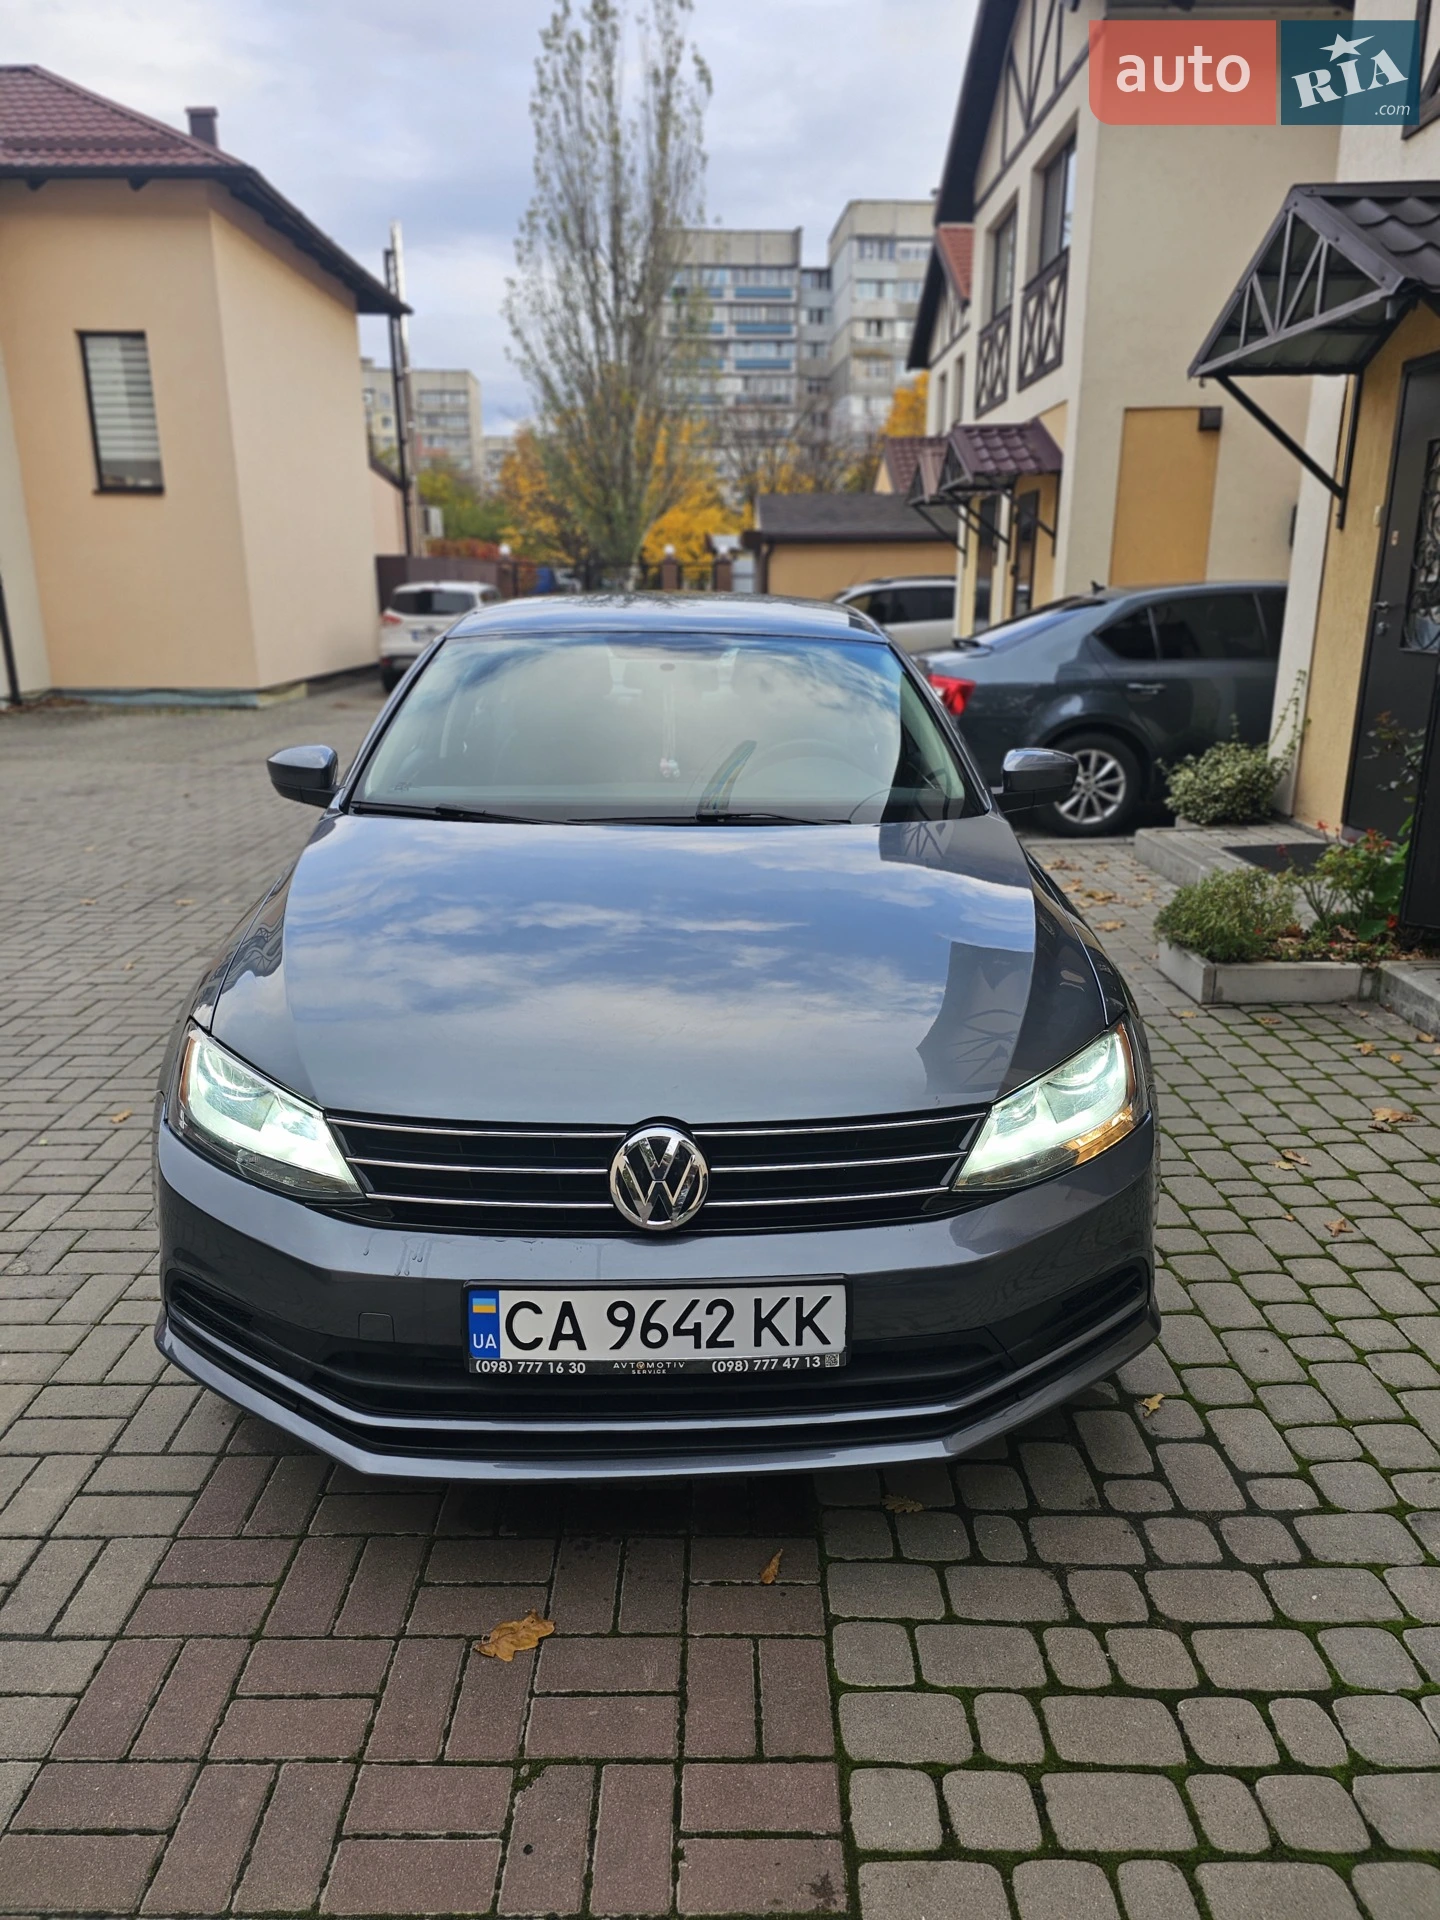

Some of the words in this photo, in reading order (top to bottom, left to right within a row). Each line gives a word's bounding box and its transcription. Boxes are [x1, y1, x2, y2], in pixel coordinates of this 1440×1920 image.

[504, 1300, 588, 1351] CA
[605, 1298, 735, 1350] 9642
[753, 1295, 833, 1348] KK
[472, 1333, 497, 1350] UA
[475, 1360, 513, 1374] (098)
[517, 1361, 543, 1374] 777
[548, 1362, 564, 1374] 16
[568, 1362, 586, 1374] 30
[711, 1360, 749, 1373] (098)
[753, 1358, 779, 1371] 777
[782, 1357, 800, 1369] 47
[804, 1356, 821, 1368] 13
